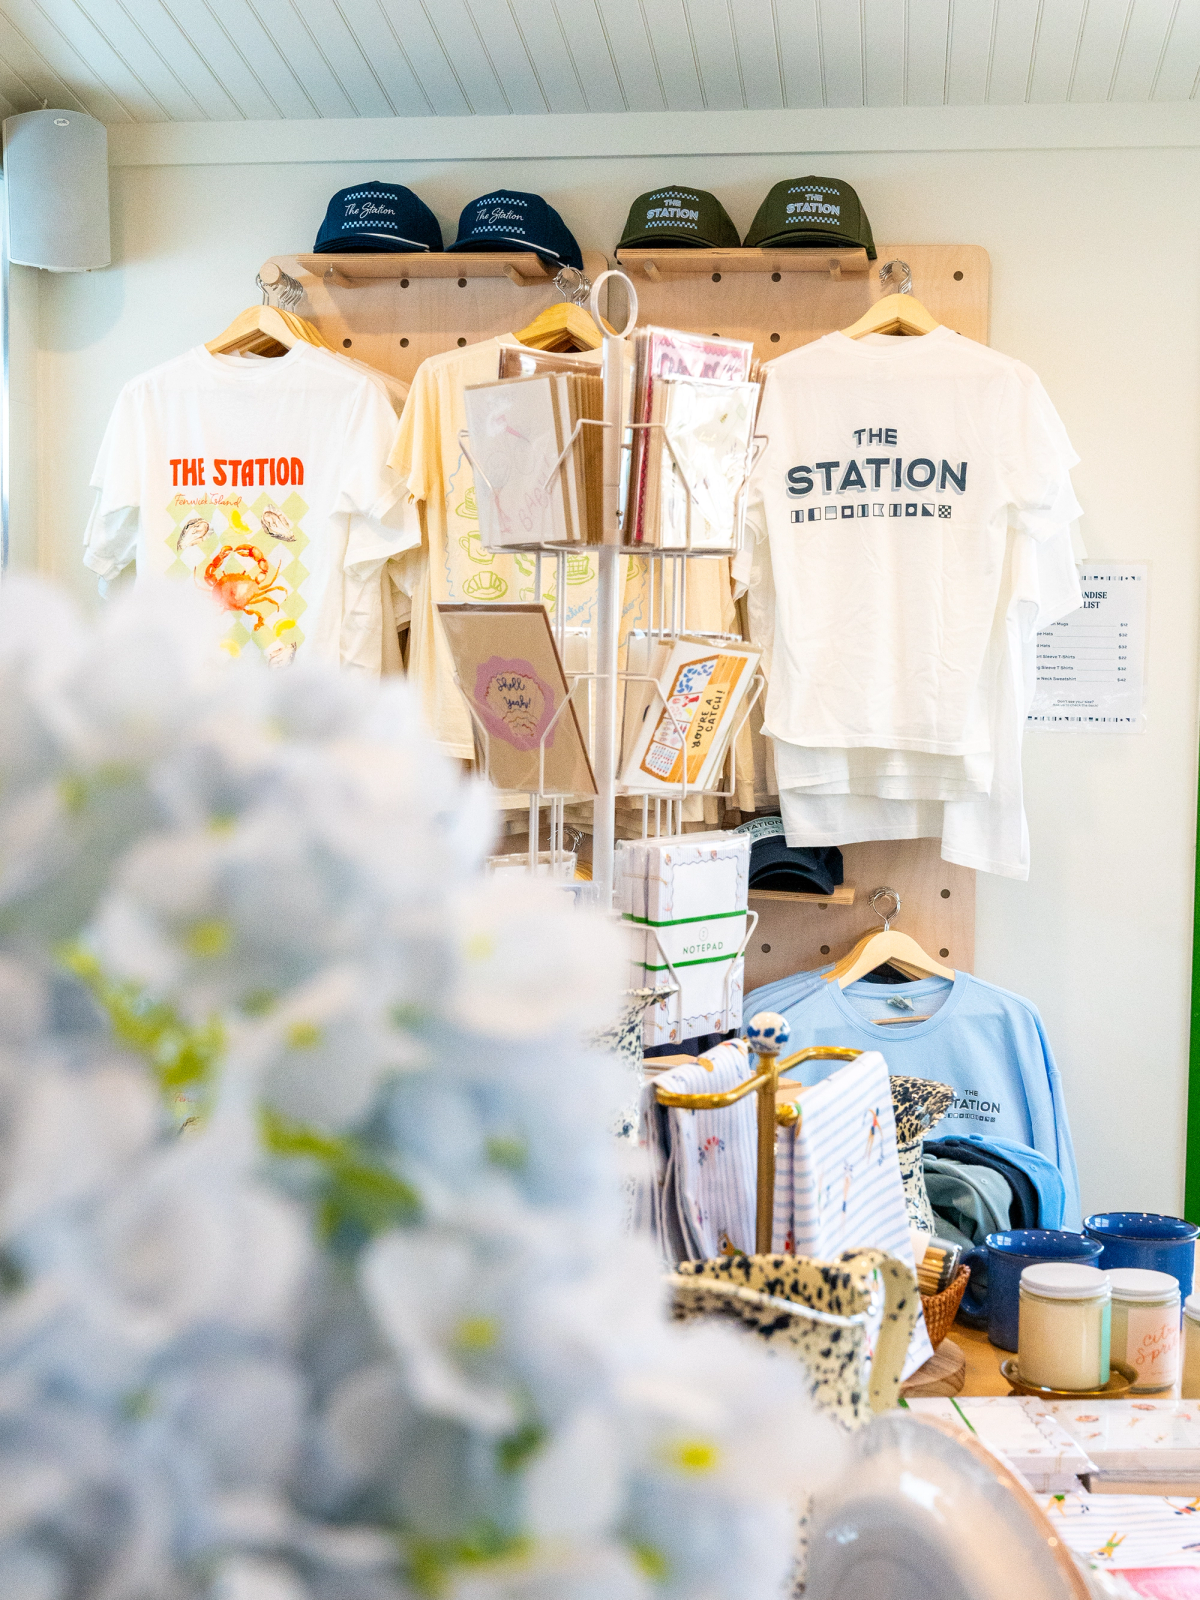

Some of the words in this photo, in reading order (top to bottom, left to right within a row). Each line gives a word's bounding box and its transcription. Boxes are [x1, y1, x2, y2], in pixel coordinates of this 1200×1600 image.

[805, 193, 823, 201] THE
[345, 203, 359, 216] The
[360, 202, 395, 218] Station
[476, 208, 489, 221] The
[488, 207, 524, 223] Station
[647, 208, 699, 220] STATION
[786, 202, 840, 216] STATION
[853, 428, 898, 447] THE
[169, 458, 206, 486] THE
[212, 457, 304, 486] STATION
[785, 458, 968, 499] STATION
[209, 492, 242, 508] Island
[1083, 601, 1101, 609] LIST
[496, 677, 526, 691] Shell
[706, 698, 713, 706] A
[705, 690, 726, 732] CATCH!
[683, 941, 724, 955] NOTEPAD
[953, 1099, 1000, 1113] TATION
